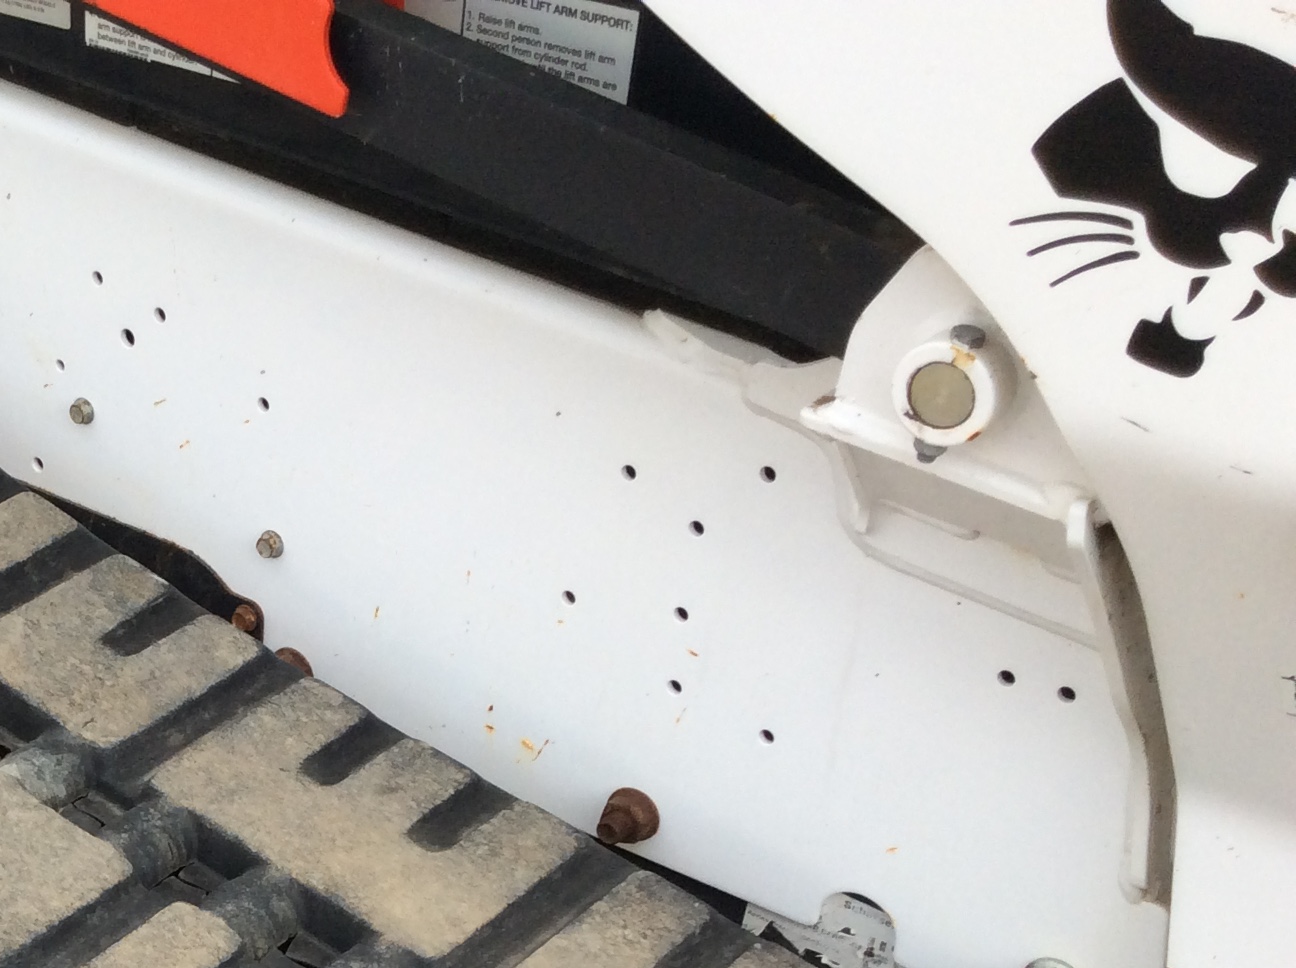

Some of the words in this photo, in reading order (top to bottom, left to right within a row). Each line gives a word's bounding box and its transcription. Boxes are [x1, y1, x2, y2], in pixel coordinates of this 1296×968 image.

[467, 10, 474, 20] 1.
[478, 12, 503, 26] Raise
[504, 17, 515, 29] lift
[530, 0, 552, 13] LIFT
[553, 4, 577, 18] ARM
[580, 11, 633, 32] SUPPORT:
[476, 24, 509, 40] Second
[511, 34, 541, 48] person
[544, 42, 582, 57] removes
[584, 49, 596, 61] lift
[598, 55, 616, 66] arm
[511, 45, 532, 58] from
[534, 51, 568, 67] cylinder
[577, 74, 600, 88] arms
[601, 80, 618, 91] are
